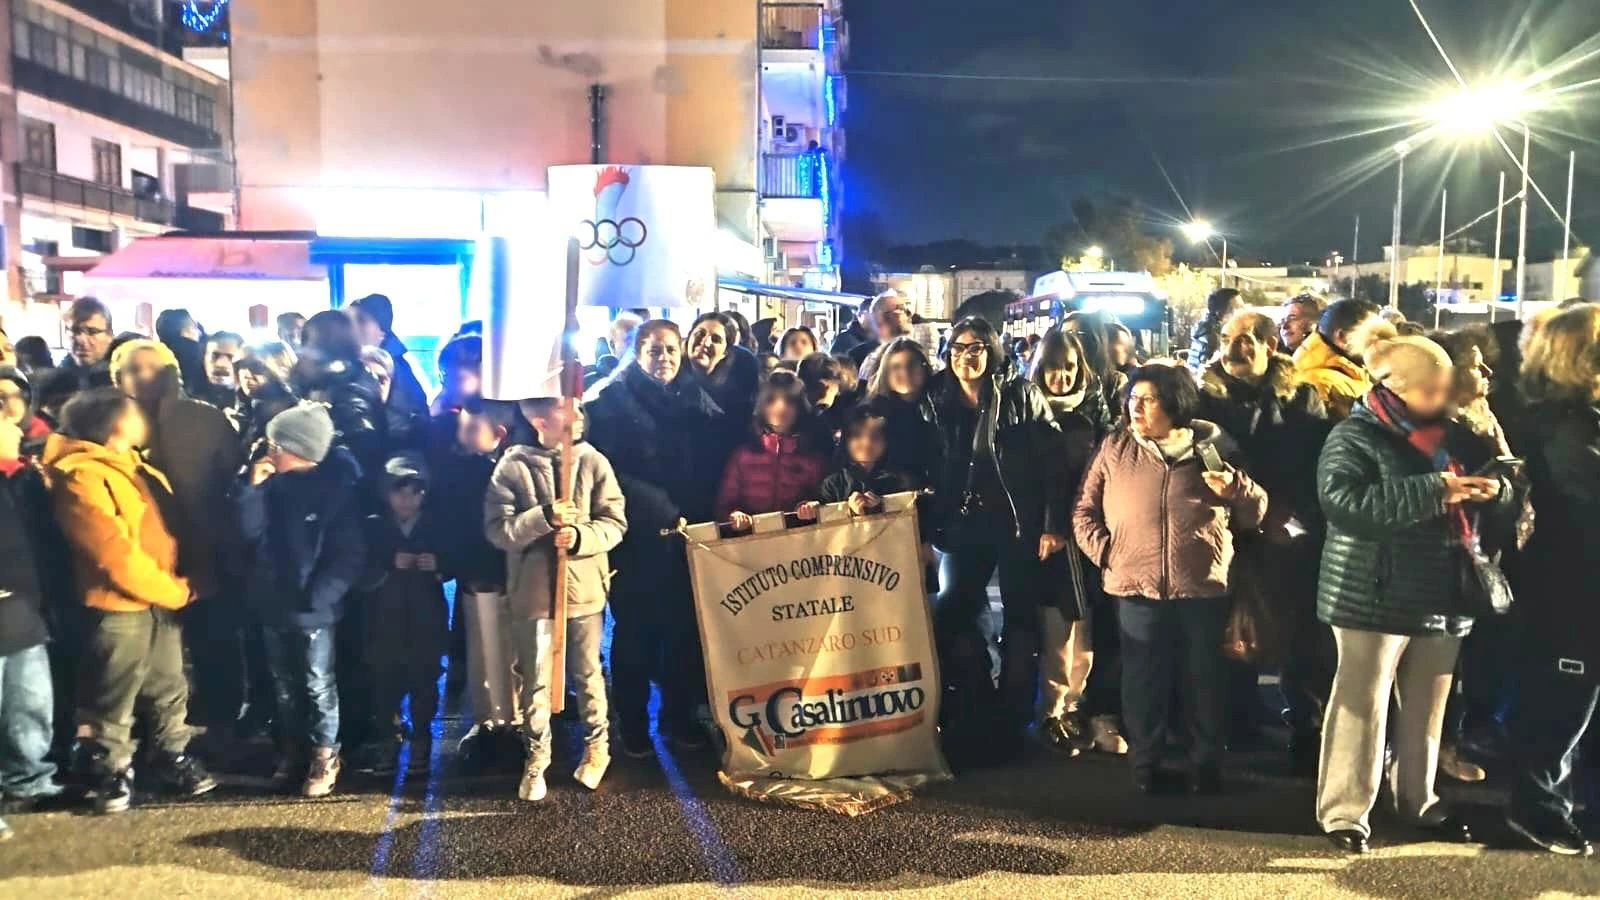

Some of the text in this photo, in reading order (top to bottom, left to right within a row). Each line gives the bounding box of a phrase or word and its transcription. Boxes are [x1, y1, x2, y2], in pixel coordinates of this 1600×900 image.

[720, 554, 900, 616] ISTITUTO COMPRENSIVO
[772, 595, 855, 622] STATALE
[737, 626, 901, 665] CATANZARO SUD
[765, 686, 925, 738] Casalinuovo
